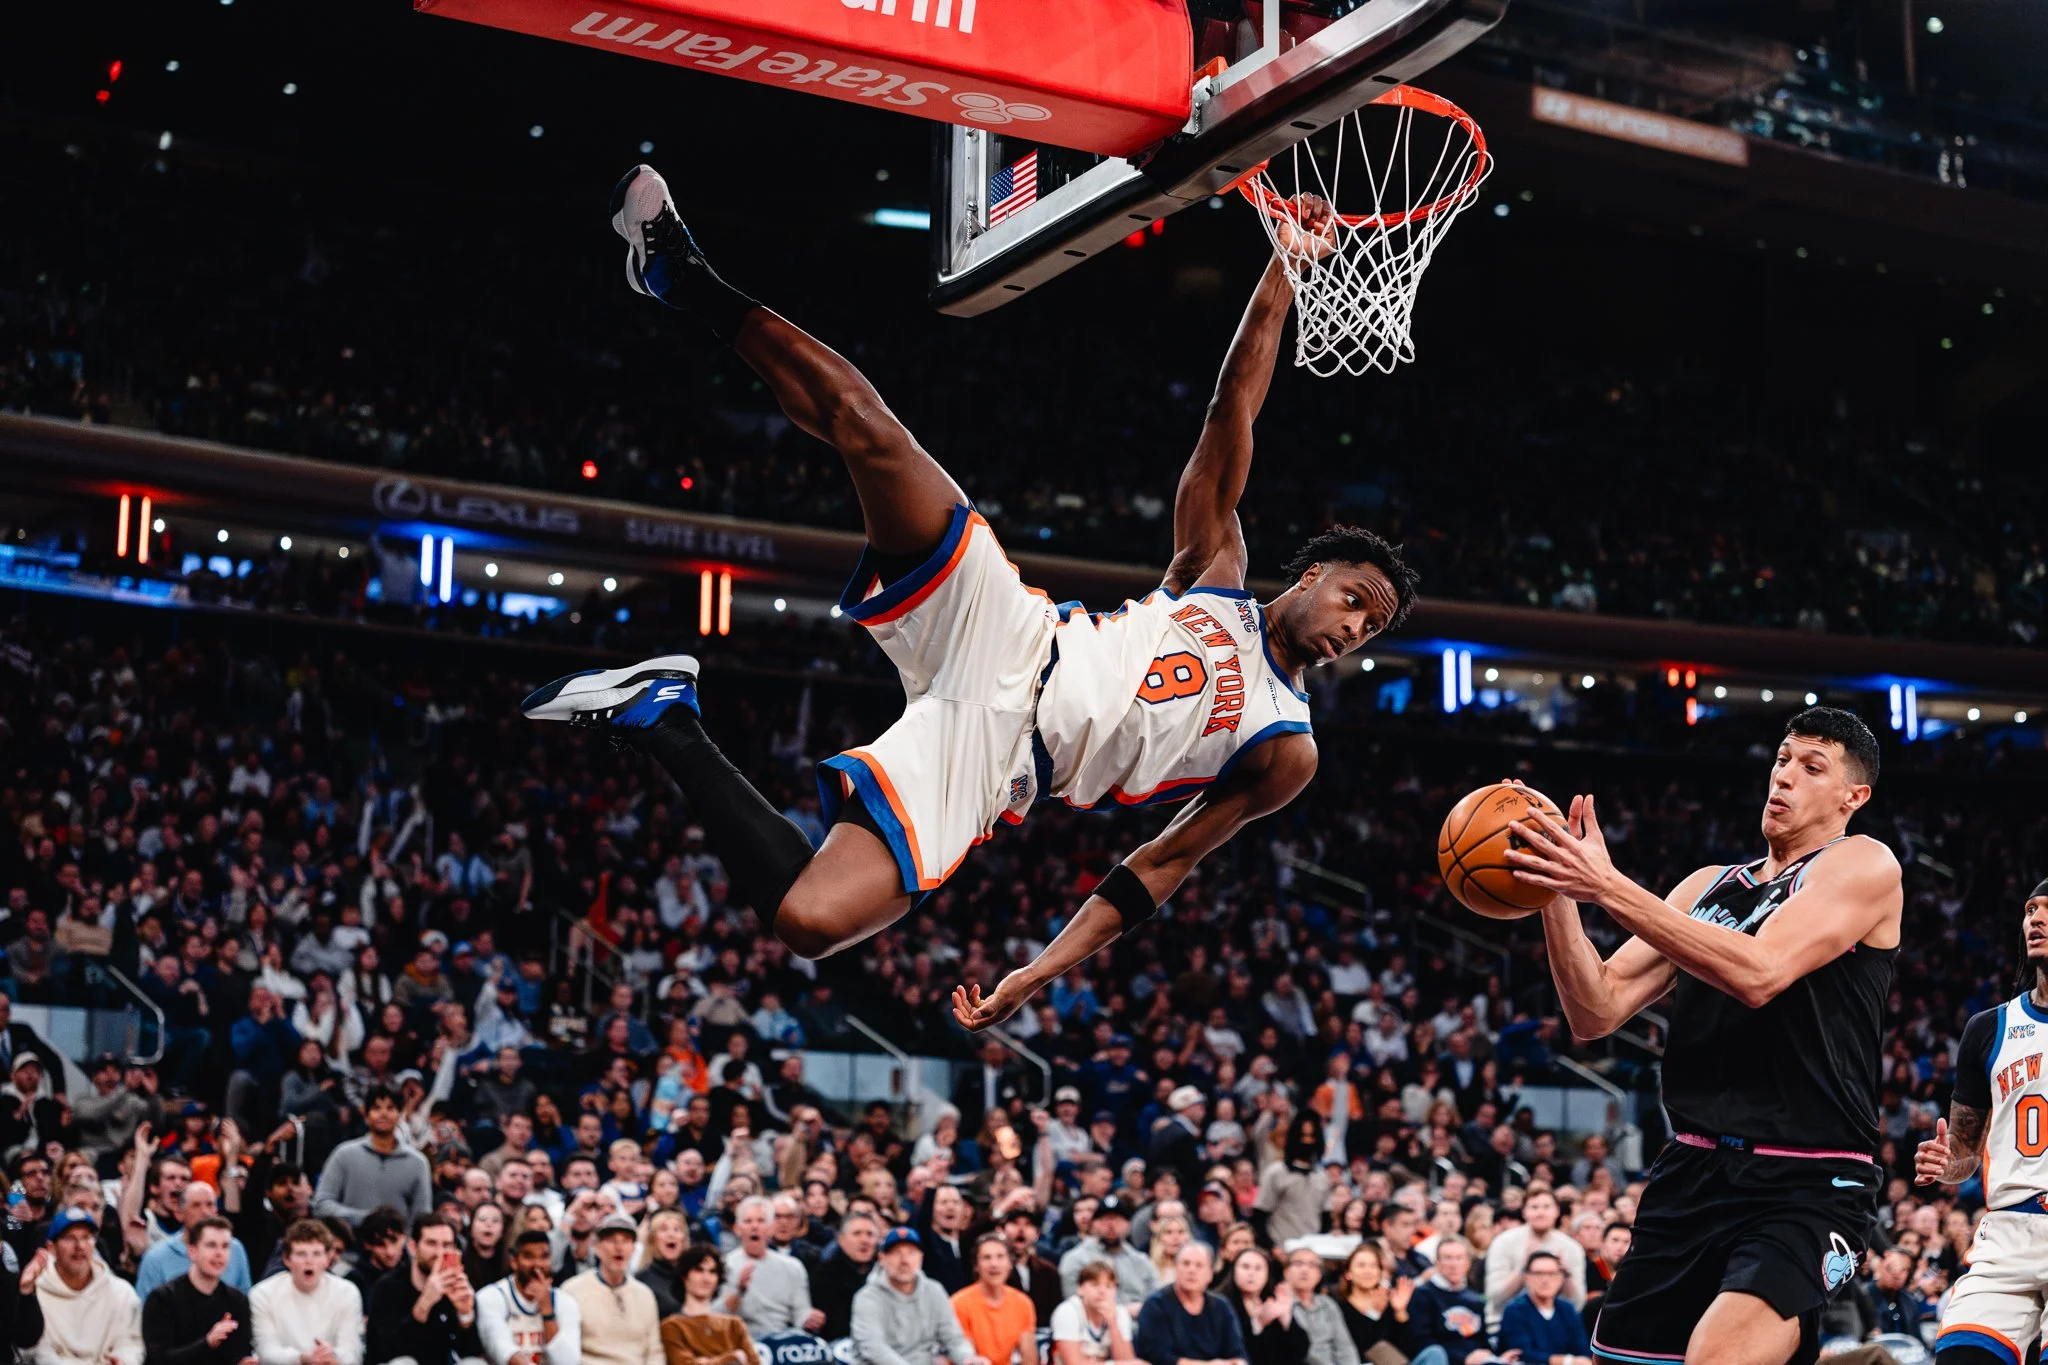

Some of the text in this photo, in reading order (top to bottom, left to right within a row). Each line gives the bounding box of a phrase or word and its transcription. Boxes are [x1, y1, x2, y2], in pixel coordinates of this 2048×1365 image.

[431, 492, 579, 534] LEXUS
[626, 518, 775, 561] SUITE LEVEL
[1235, 600, 1258, 633] NYC
[1136, 650, 1209, 705] 8
[1168, 604, 1246, 737] NEW YORK
[2007, 1024, 2036, 1040] NYC
[1997, 1052, 2044, 1102] NEW
